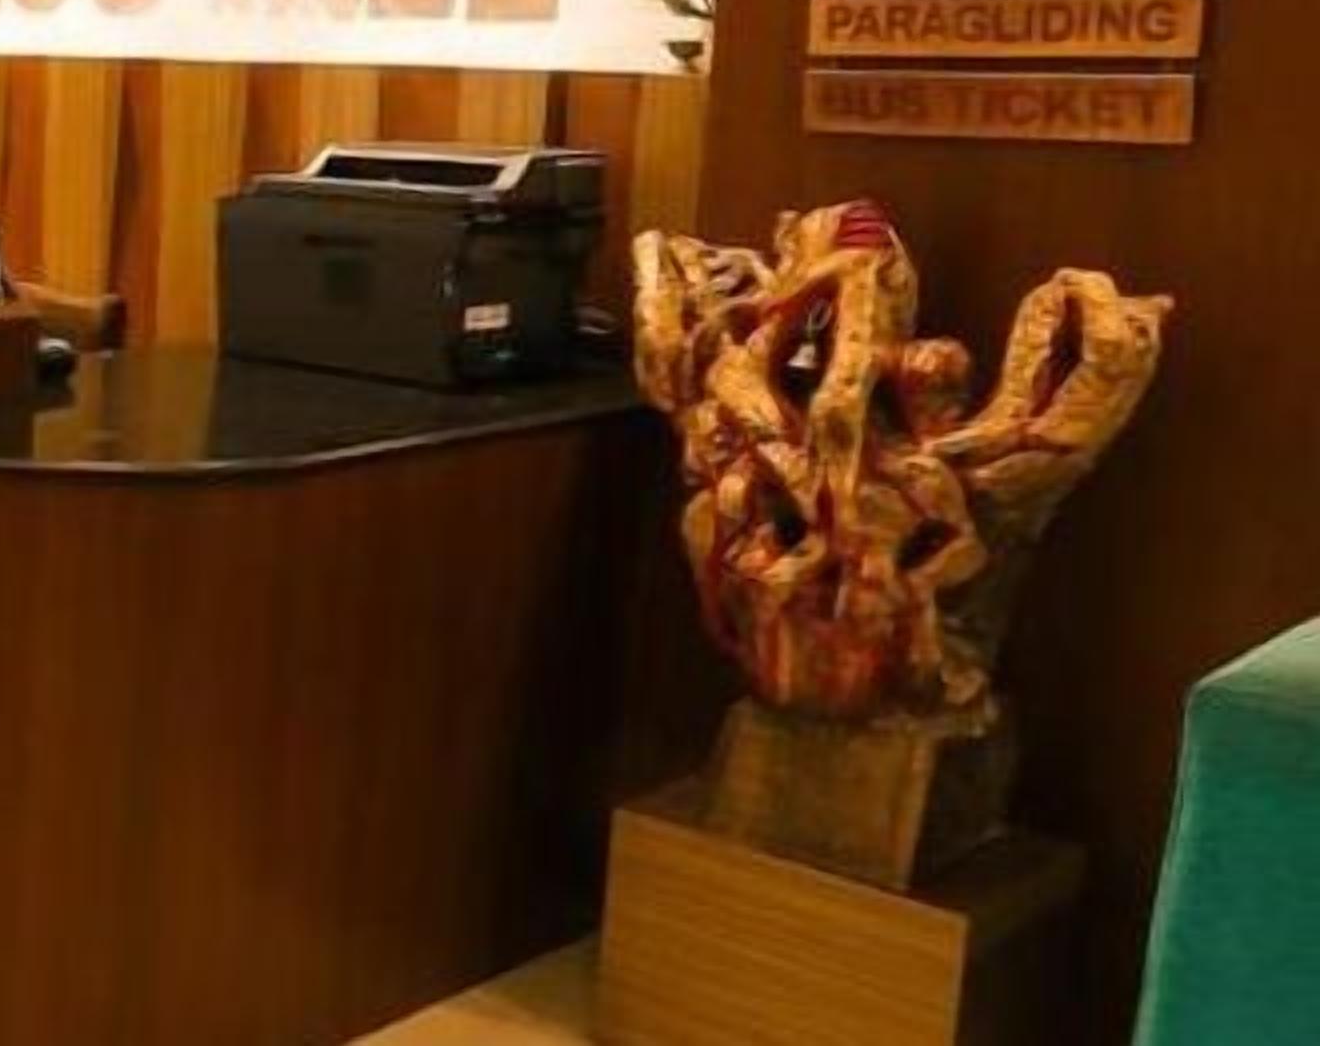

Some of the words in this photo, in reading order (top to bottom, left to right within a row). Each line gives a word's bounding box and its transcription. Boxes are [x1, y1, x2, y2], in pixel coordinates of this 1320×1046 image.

[826, 1, 1179, 43] PARAGLIDING
[819, 82, 928, 123] BUS
[948, 84, 1168, 130] TICKET
